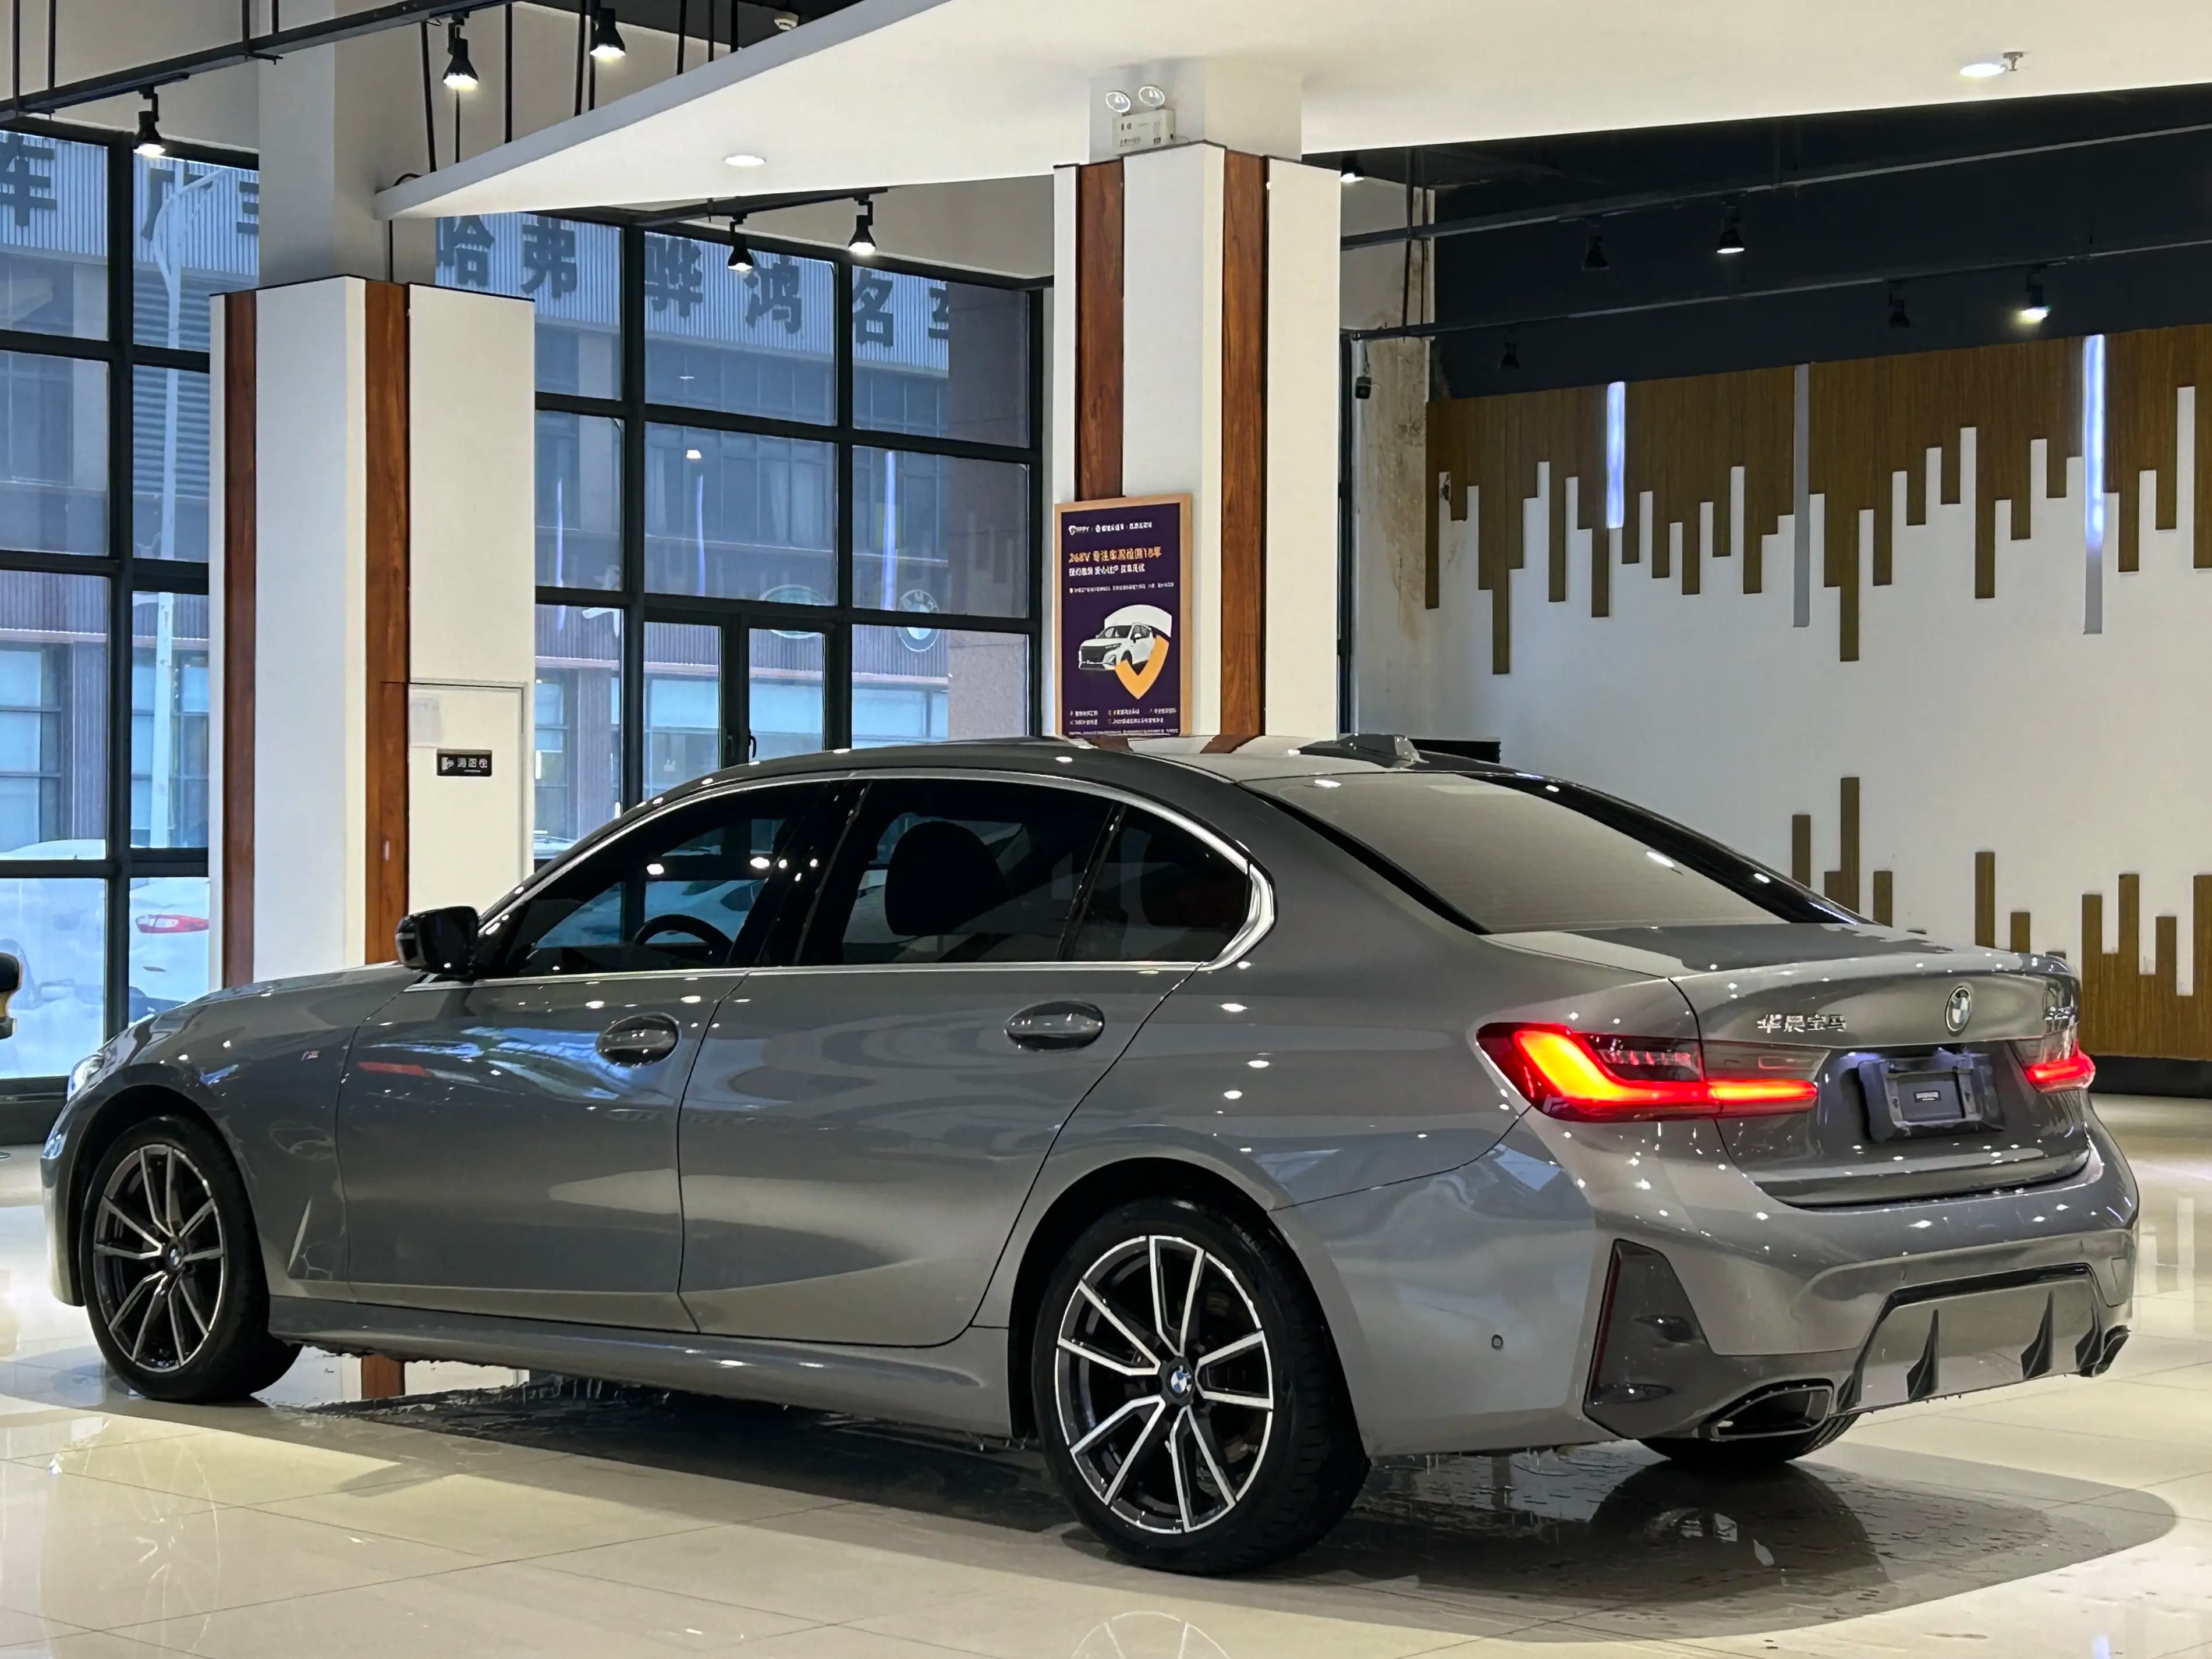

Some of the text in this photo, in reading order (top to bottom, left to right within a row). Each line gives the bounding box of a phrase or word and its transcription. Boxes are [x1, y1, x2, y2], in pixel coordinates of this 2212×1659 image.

[434, 215, 576, 299] 哈弗
[1756, 1013, 1847, 1034] 华晨宝马
